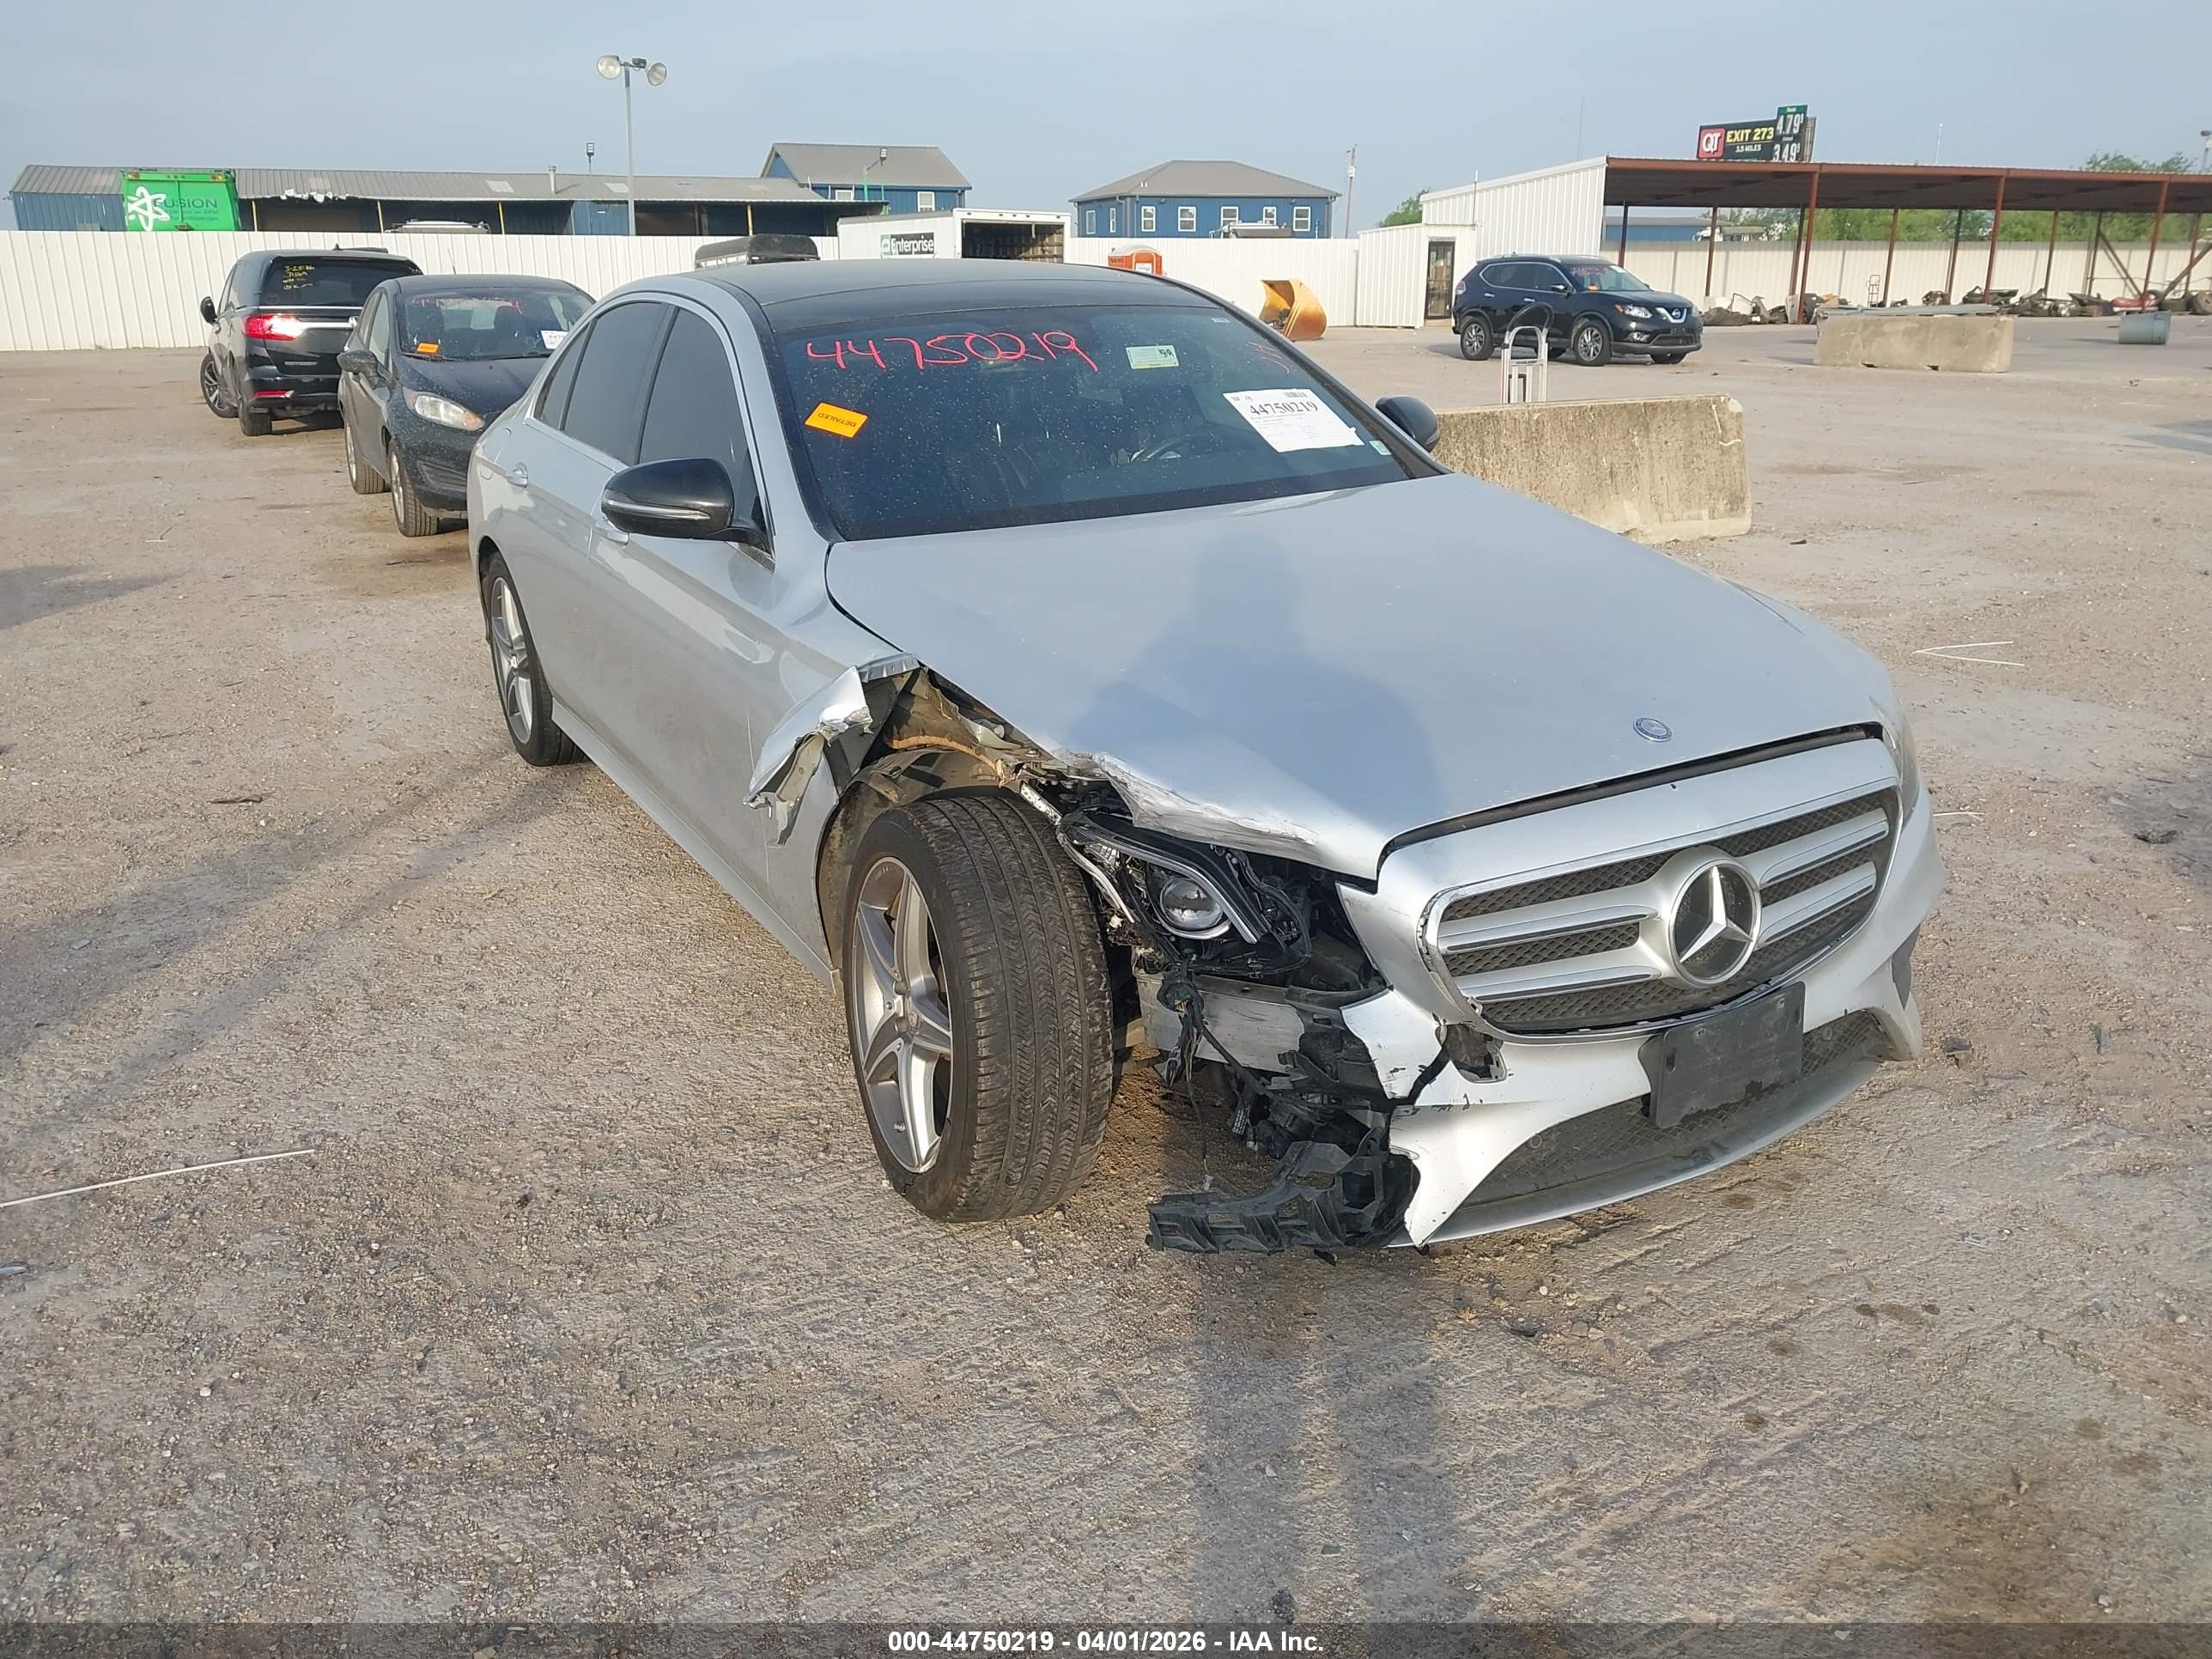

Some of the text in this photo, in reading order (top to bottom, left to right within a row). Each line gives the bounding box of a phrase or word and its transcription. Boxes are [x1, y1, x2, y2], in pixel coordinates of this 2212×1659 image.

[1702, 132, 1721, 153] QT
[1726, 127, 1774, 143] EXIT 273
[890, 234, 934, 255] Enterprise
[806, 330, 1098, 372] 44750219
[1249, 400, 1318, 416] 44750219
[817, 412, 857, 428] DETAILED
